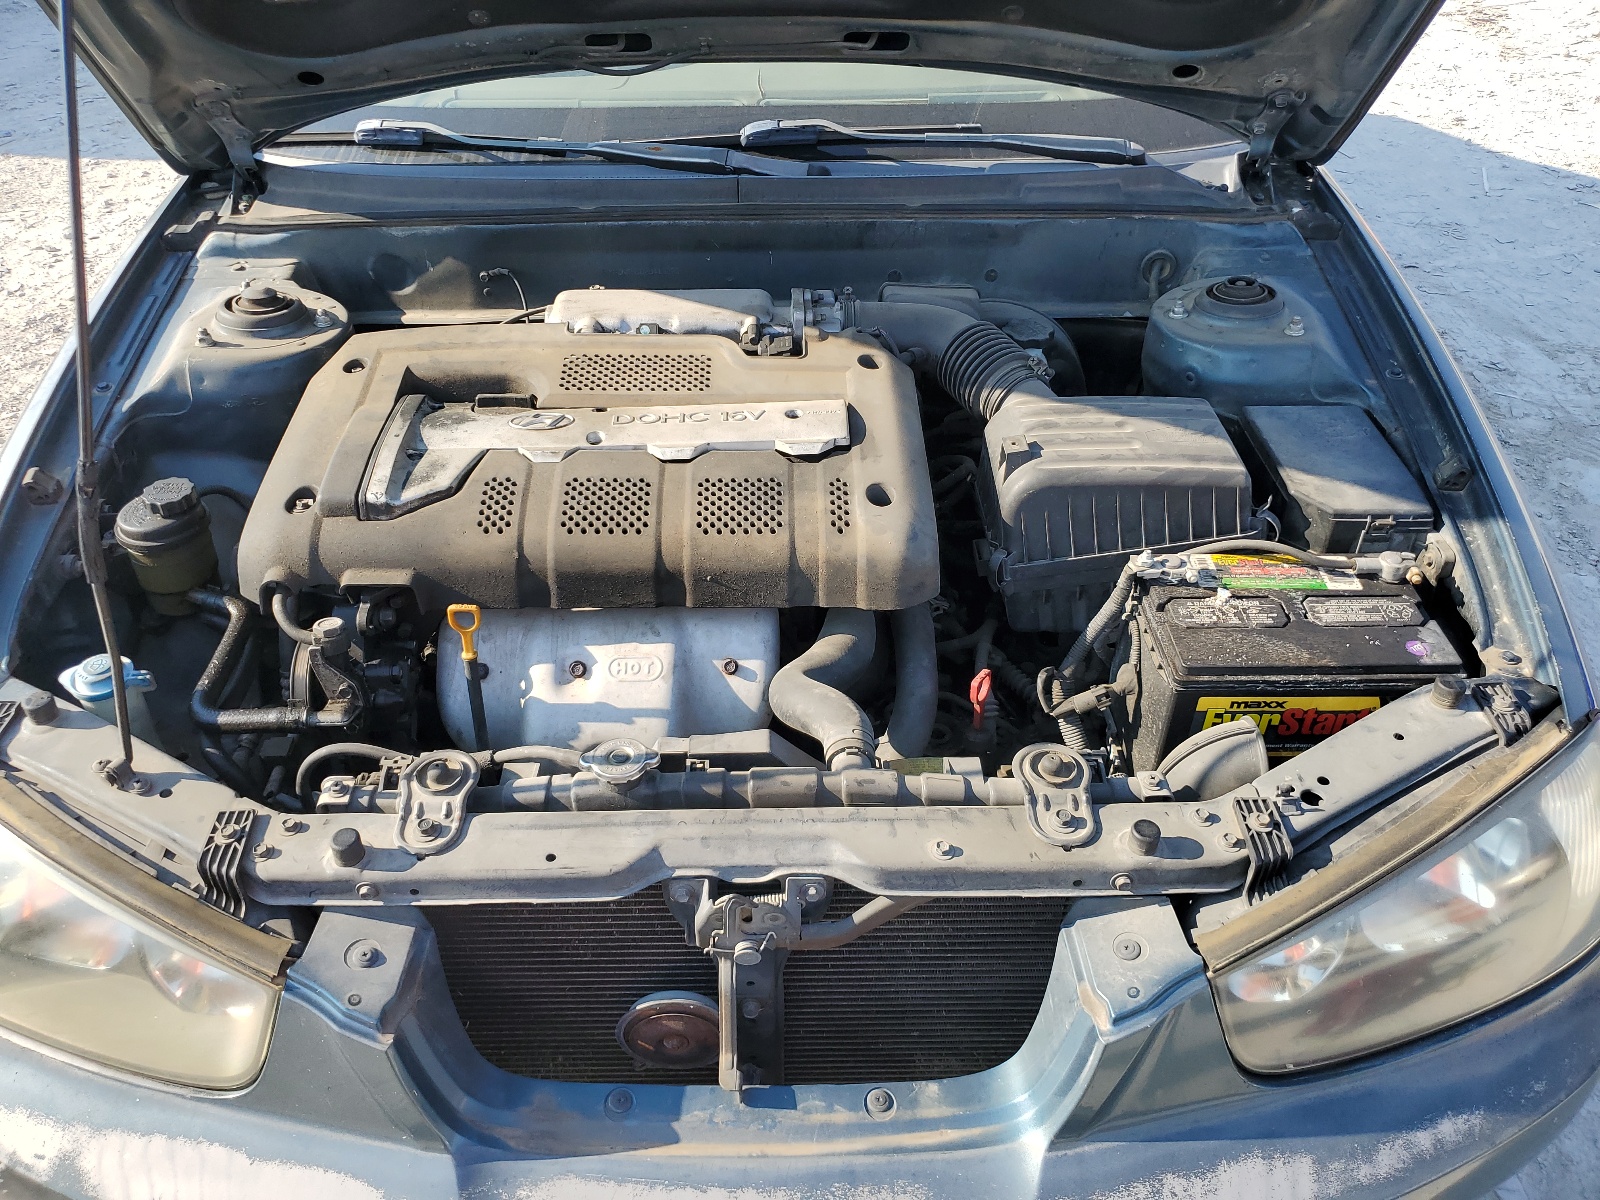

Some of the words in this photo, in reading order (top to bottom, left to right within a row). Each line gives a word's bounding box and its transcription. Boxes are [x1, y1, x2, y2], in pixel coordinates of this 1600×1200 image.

[612, 411, 711, 425] DOHC
[720, 409, 766, 422] 16V
[616, 661, 656, 675] HOT
[1229, 700, 1288, 709] maxx
[1202, 707, 1372, 736] ErStar
